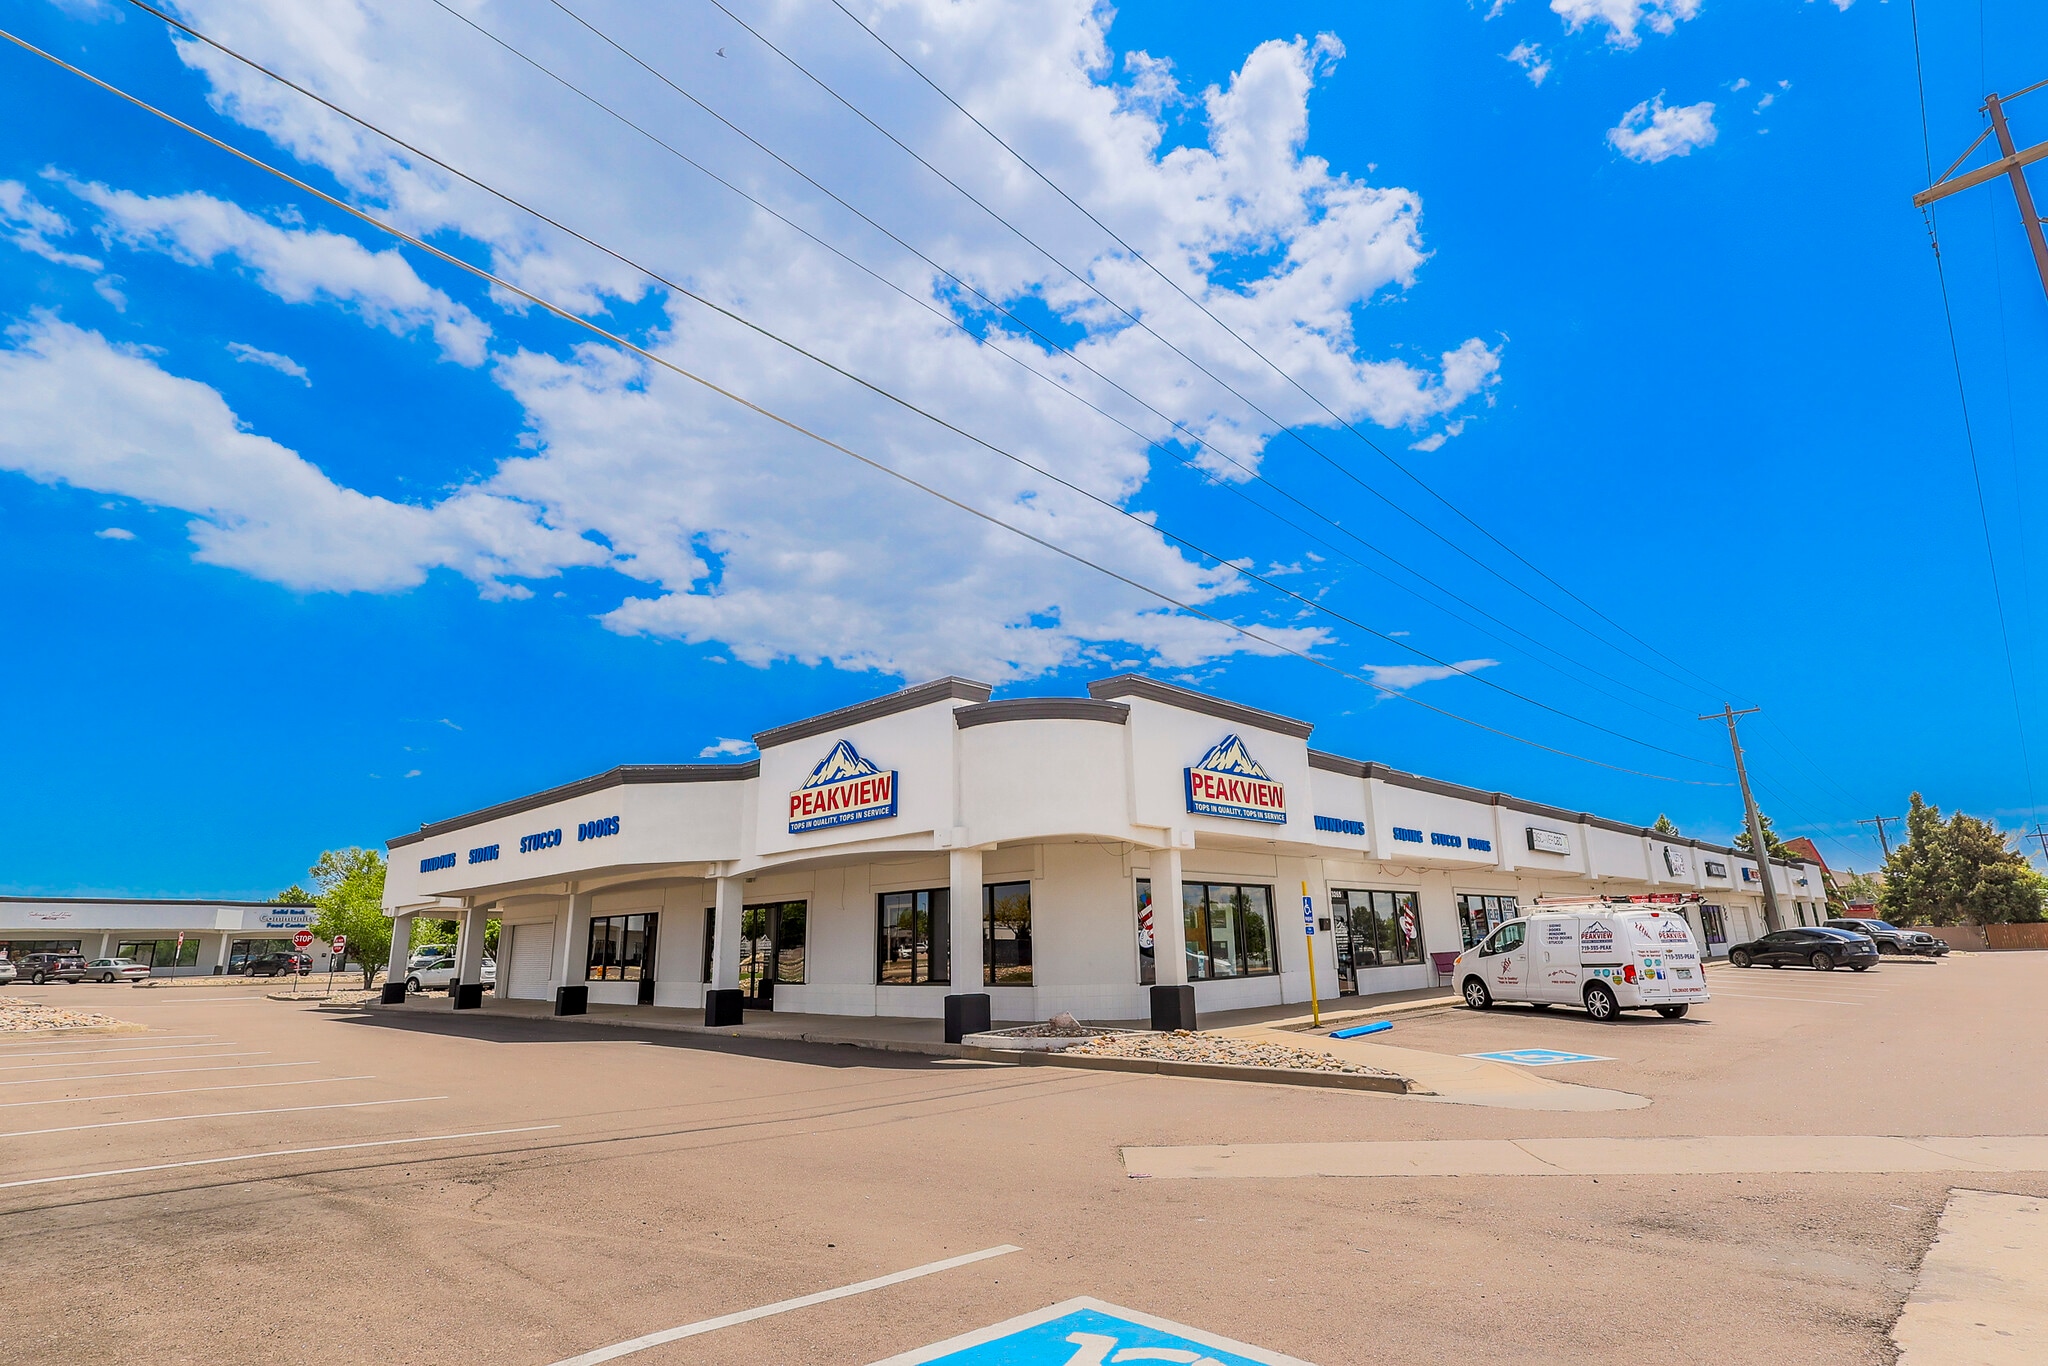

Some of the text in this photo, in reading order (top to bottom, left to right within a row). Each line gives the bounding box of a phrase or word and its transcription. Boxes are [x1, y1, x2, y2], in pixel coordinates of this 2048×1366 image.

[790, 776, 890, 818] PEAKVIEW
[1192, 772, 1282, 808] PEAKVIEW
[791, 822, 805, 830] TOPS
[806, 820, 812, 828] IN
[813, 816, 838, 826] QUALITY,
[840, 812, 854, 822] TOPS
[864, 807, 889, 817] SERVICE
[1195, 803, 1210, 811] TOPS
[1218, 806, 1242, 816] QUALITY,
[1264, 812, 1285, 821] SERVICE
[1314, 815, 1364, 835] WINDOWS
[420, 816, 620, 873] WINDOWS SIDING STUCCO DOORS
[1393, 827, 1491, 852] SIDING STUCCO DOORS
